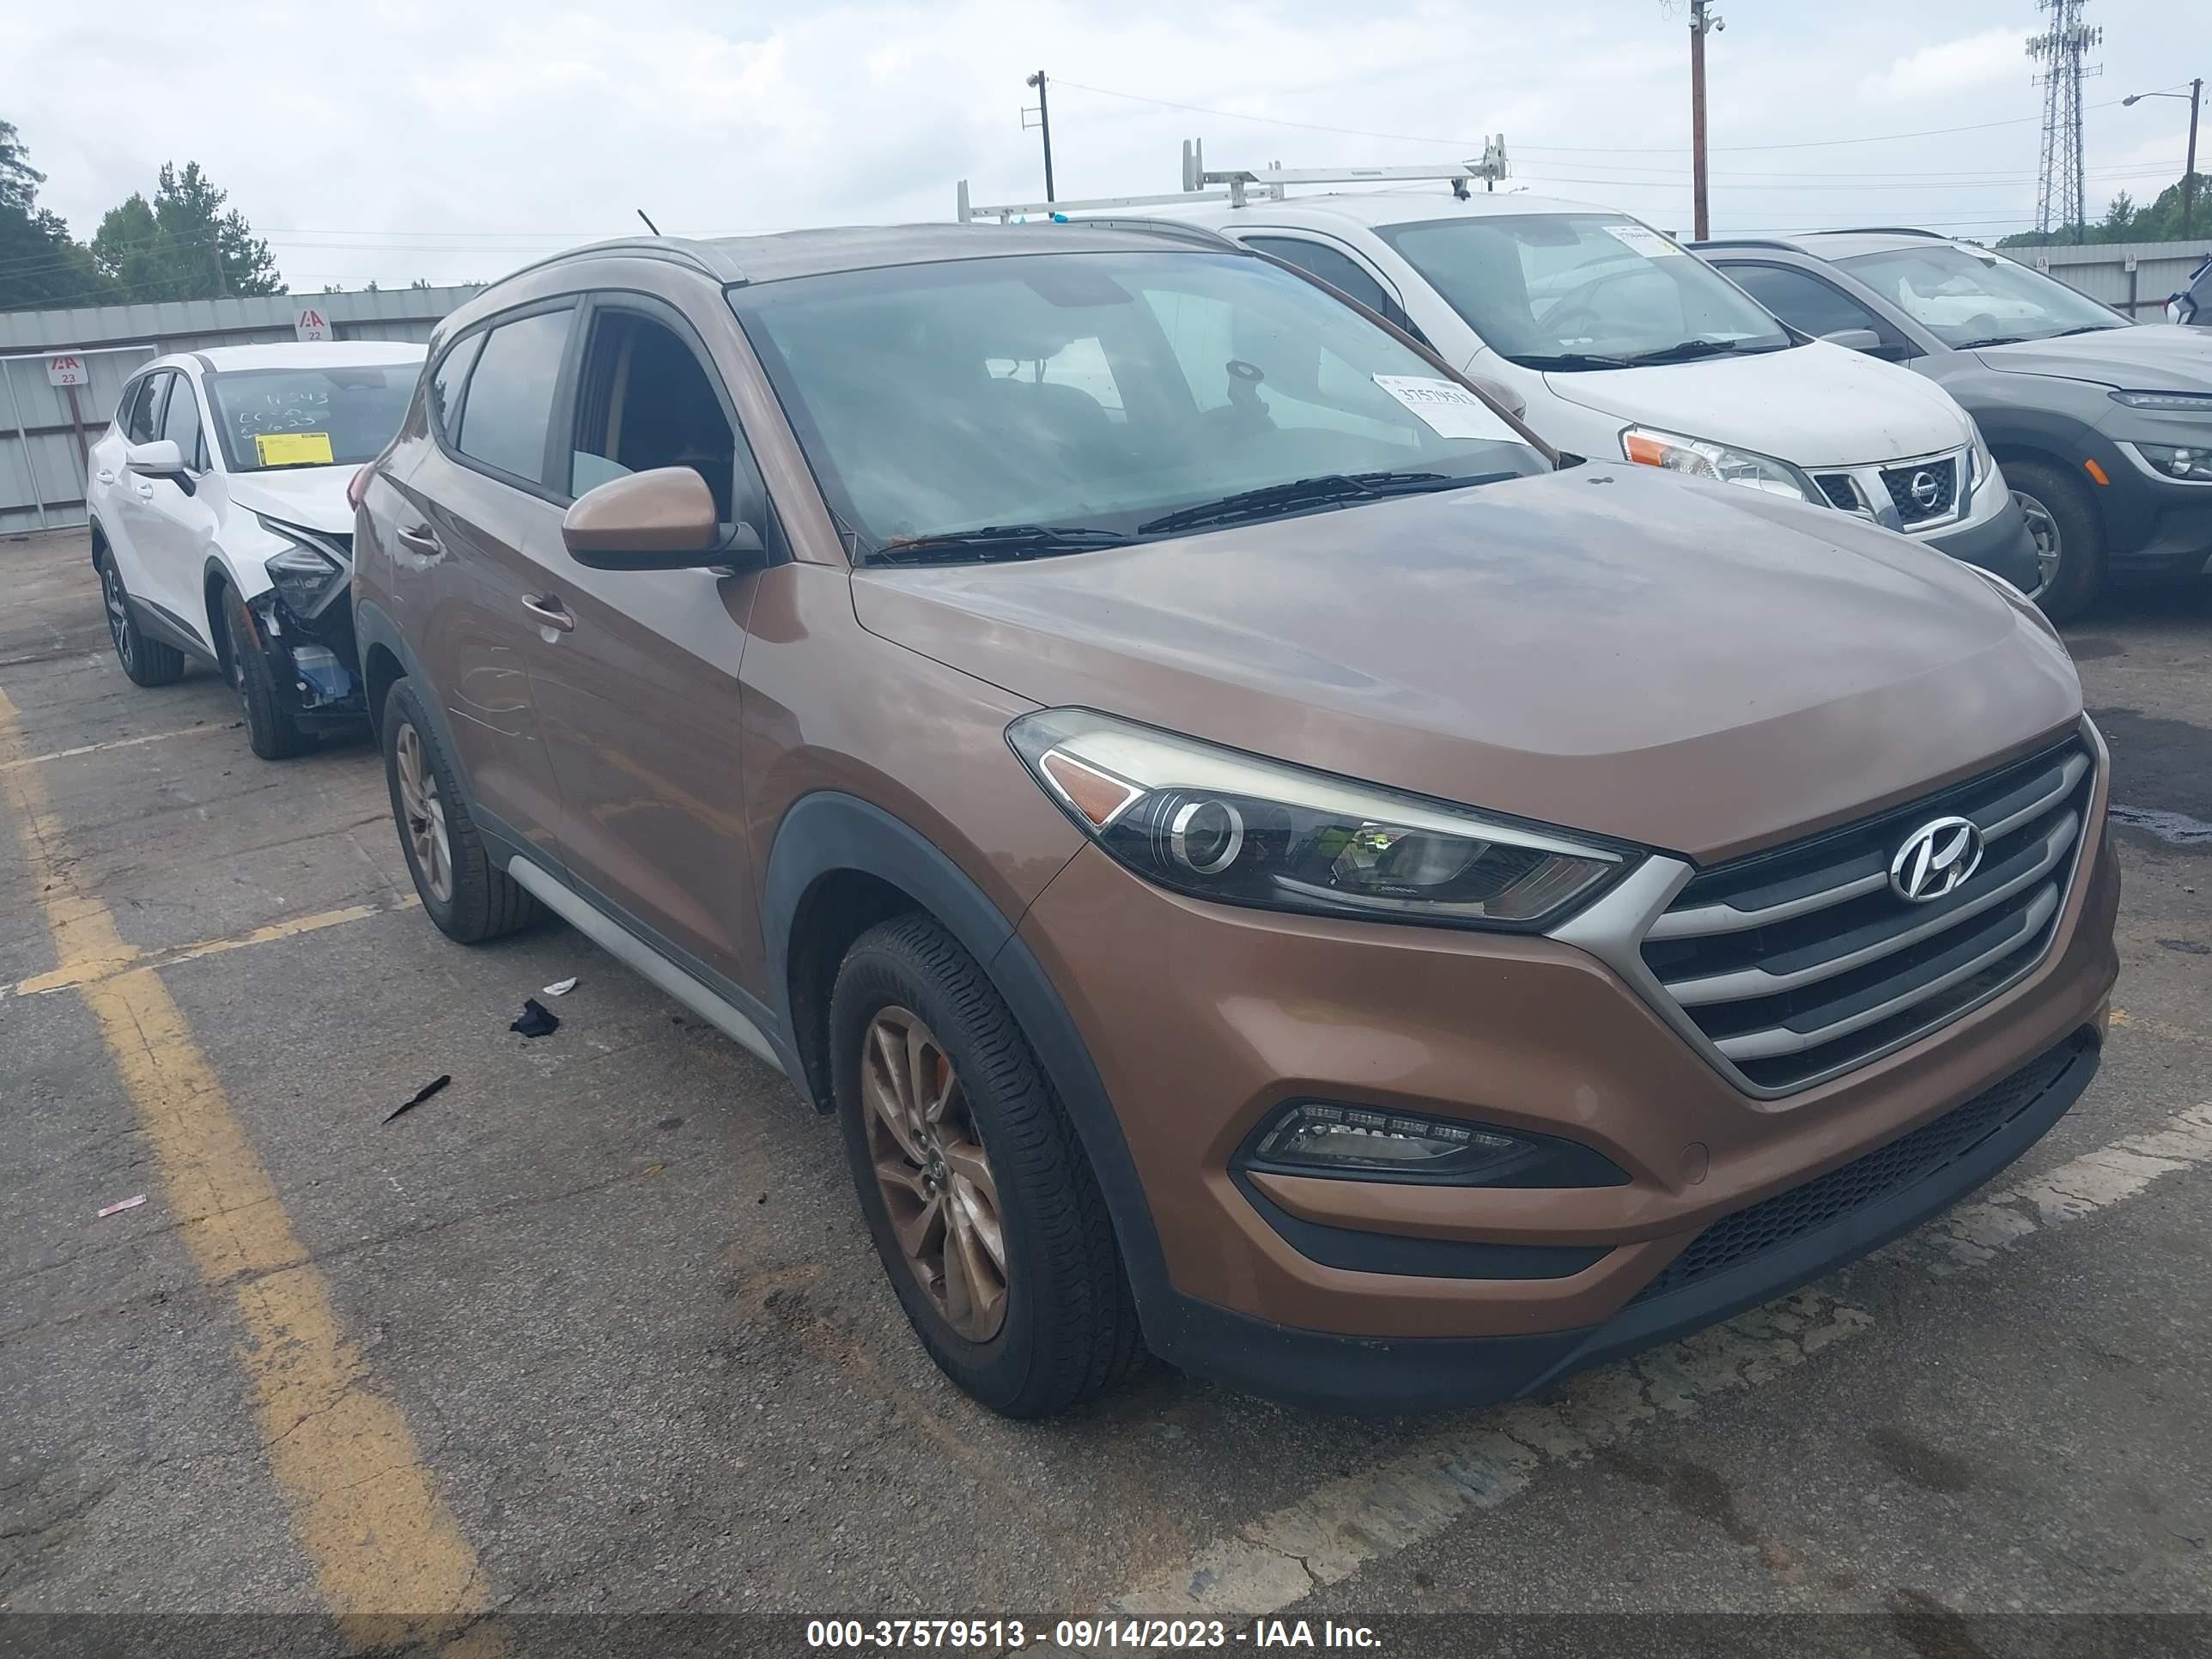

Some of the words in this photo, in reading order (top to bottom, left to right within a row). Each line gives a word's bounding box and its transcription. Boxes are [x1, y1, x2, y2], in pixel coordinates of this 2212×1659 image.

[308, 331, 322, 341] 22
[61, 374, 76, 383] 23
[1397, 389, 1476, 406] 37579513
